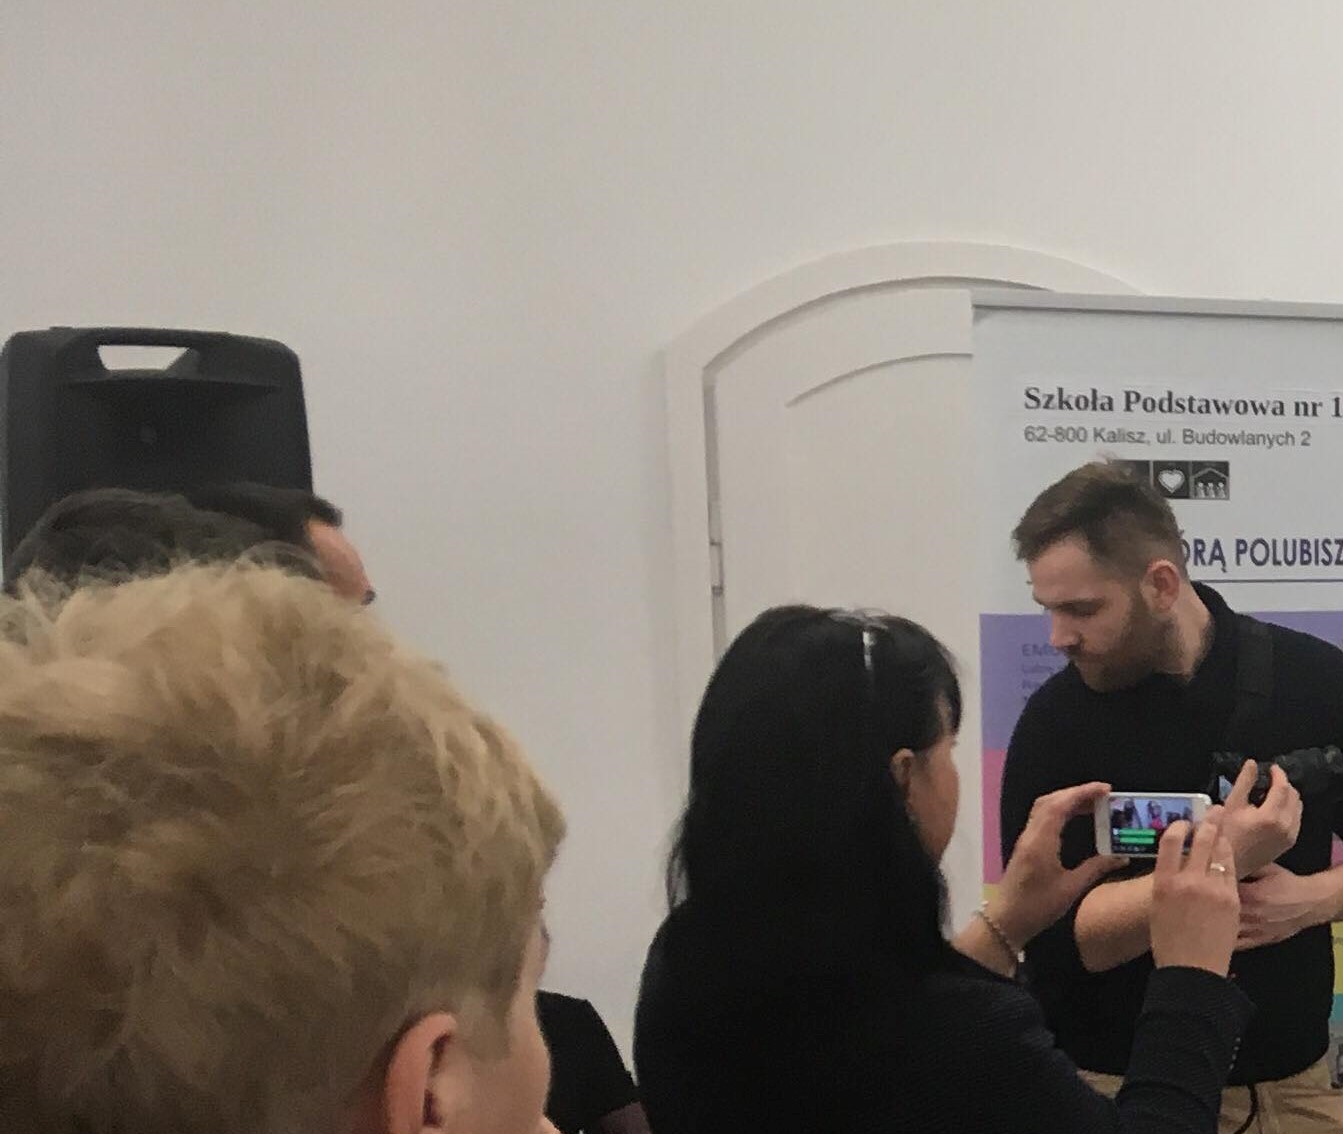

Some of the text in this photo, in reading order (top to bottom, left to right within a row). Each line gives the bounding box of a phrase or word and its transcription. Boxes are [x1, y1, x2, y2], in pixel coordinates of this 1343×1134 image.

[1024, 386, 1114, 412] Szkoła
[1123, 390, 1286, 417] Podstawowa
[1294, 399, 1323, 418] nr
[1024, 425, 1311, 449] 62-800 Kalisz, ul. Budowlanych 2
